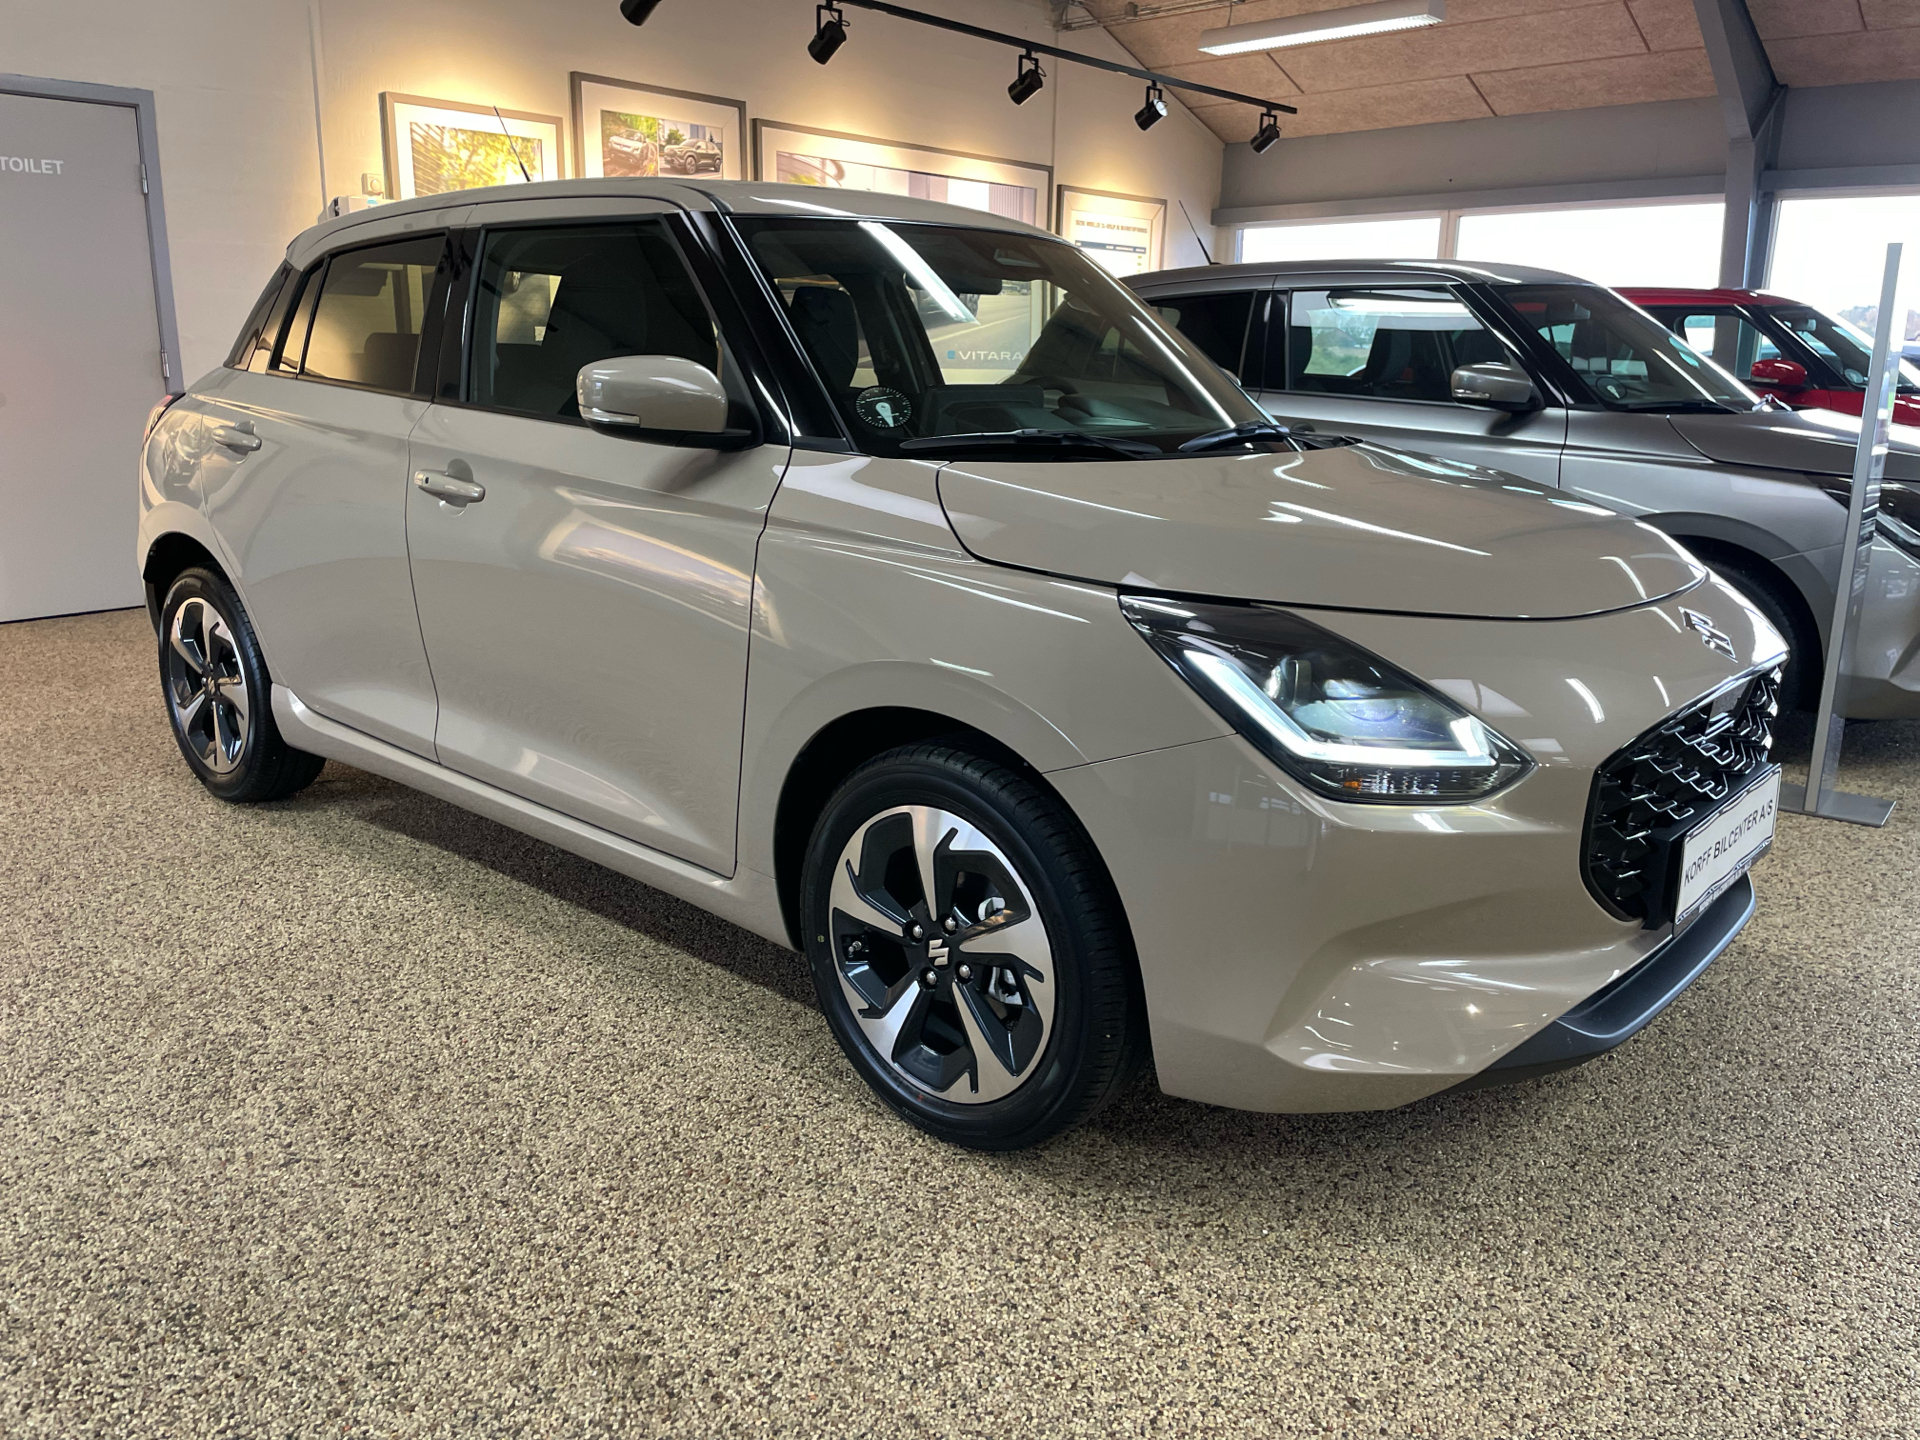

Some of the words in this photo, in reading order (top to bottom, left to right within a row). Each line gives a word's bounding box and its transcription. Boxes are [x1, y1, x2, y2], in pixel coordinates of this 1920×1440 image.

[0, 156, 64, 175] TOILET
[958, 350, 1024, 361] VITARA
[1684, 846, 1713, 887] KORFF
[1713, 813, 1758, 859] BILCENTER
[1758, 799, 1774, 826] A/S
